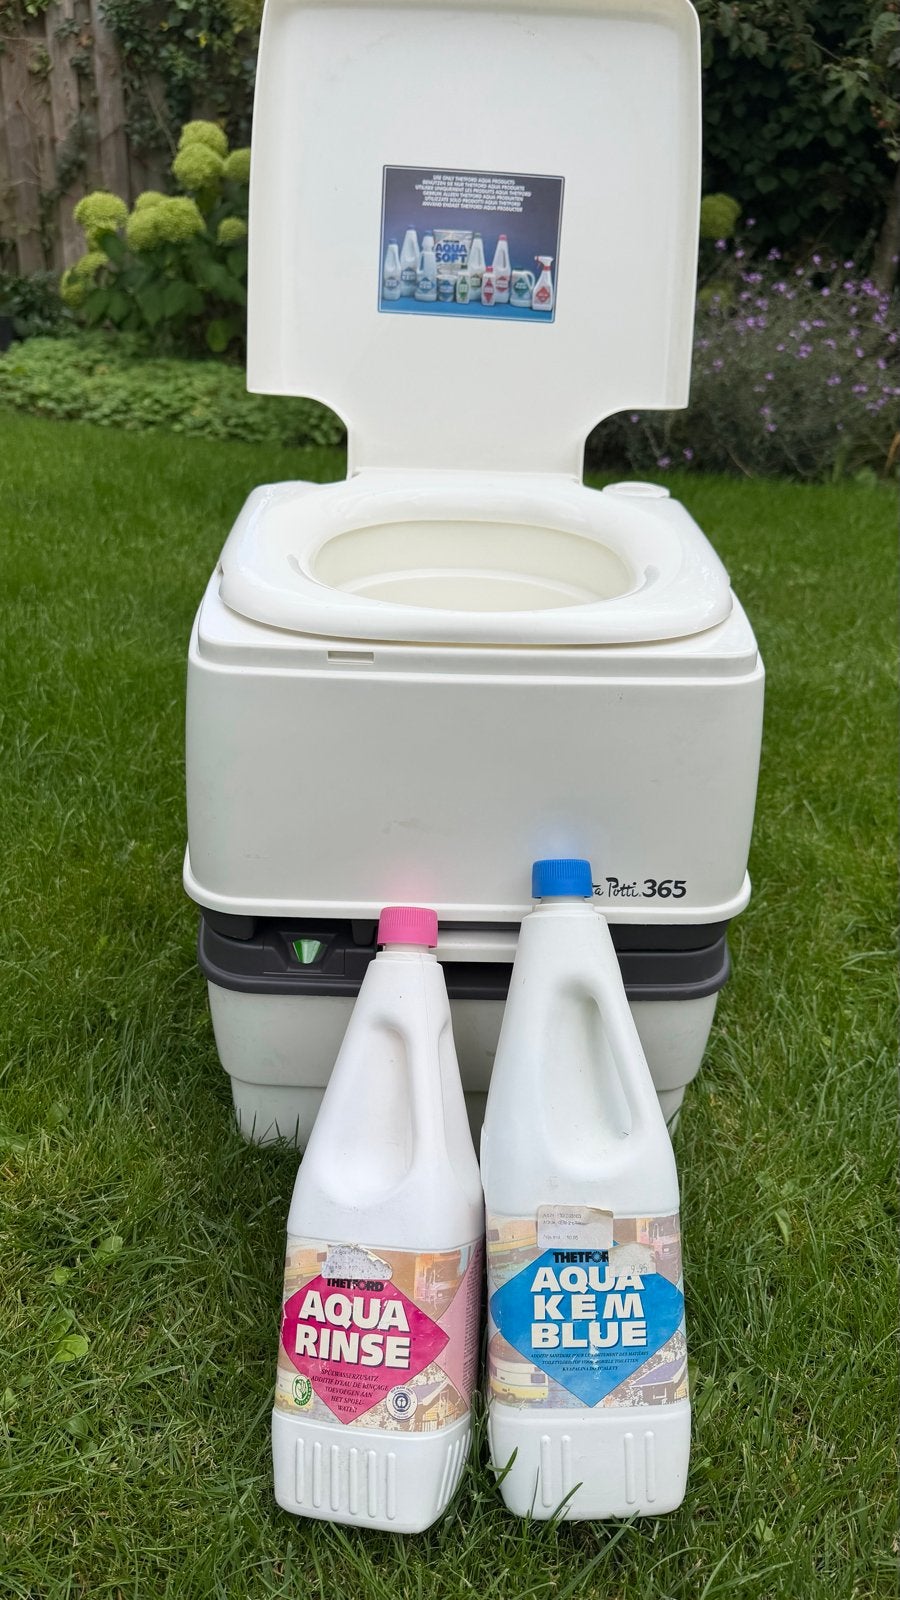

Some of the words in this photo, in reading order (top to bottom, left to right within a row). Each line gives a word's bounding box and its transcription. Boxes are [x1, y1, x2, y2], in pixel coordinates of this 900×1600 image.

[436, 244, 467, 253] AQUA
[436, 252, 467, 262] SOFT
[606, 877, 639, 897] Potti
[642, 879, 686, 898] 365
[553, 1251, 608, 1263] THETFOR
[631, 1264, 648, 1274] 9.95
[327, 1278, 384, 1292] THETFORD
[530, 1266, 645, 1294] AQUA
[299, 1290, 410, 1333] AQUA
[534, 1293, 645, 1320] KEM
[531, 1321, 648, 1349] BLUE
[295, 1324, 411, 1370] RINSE
